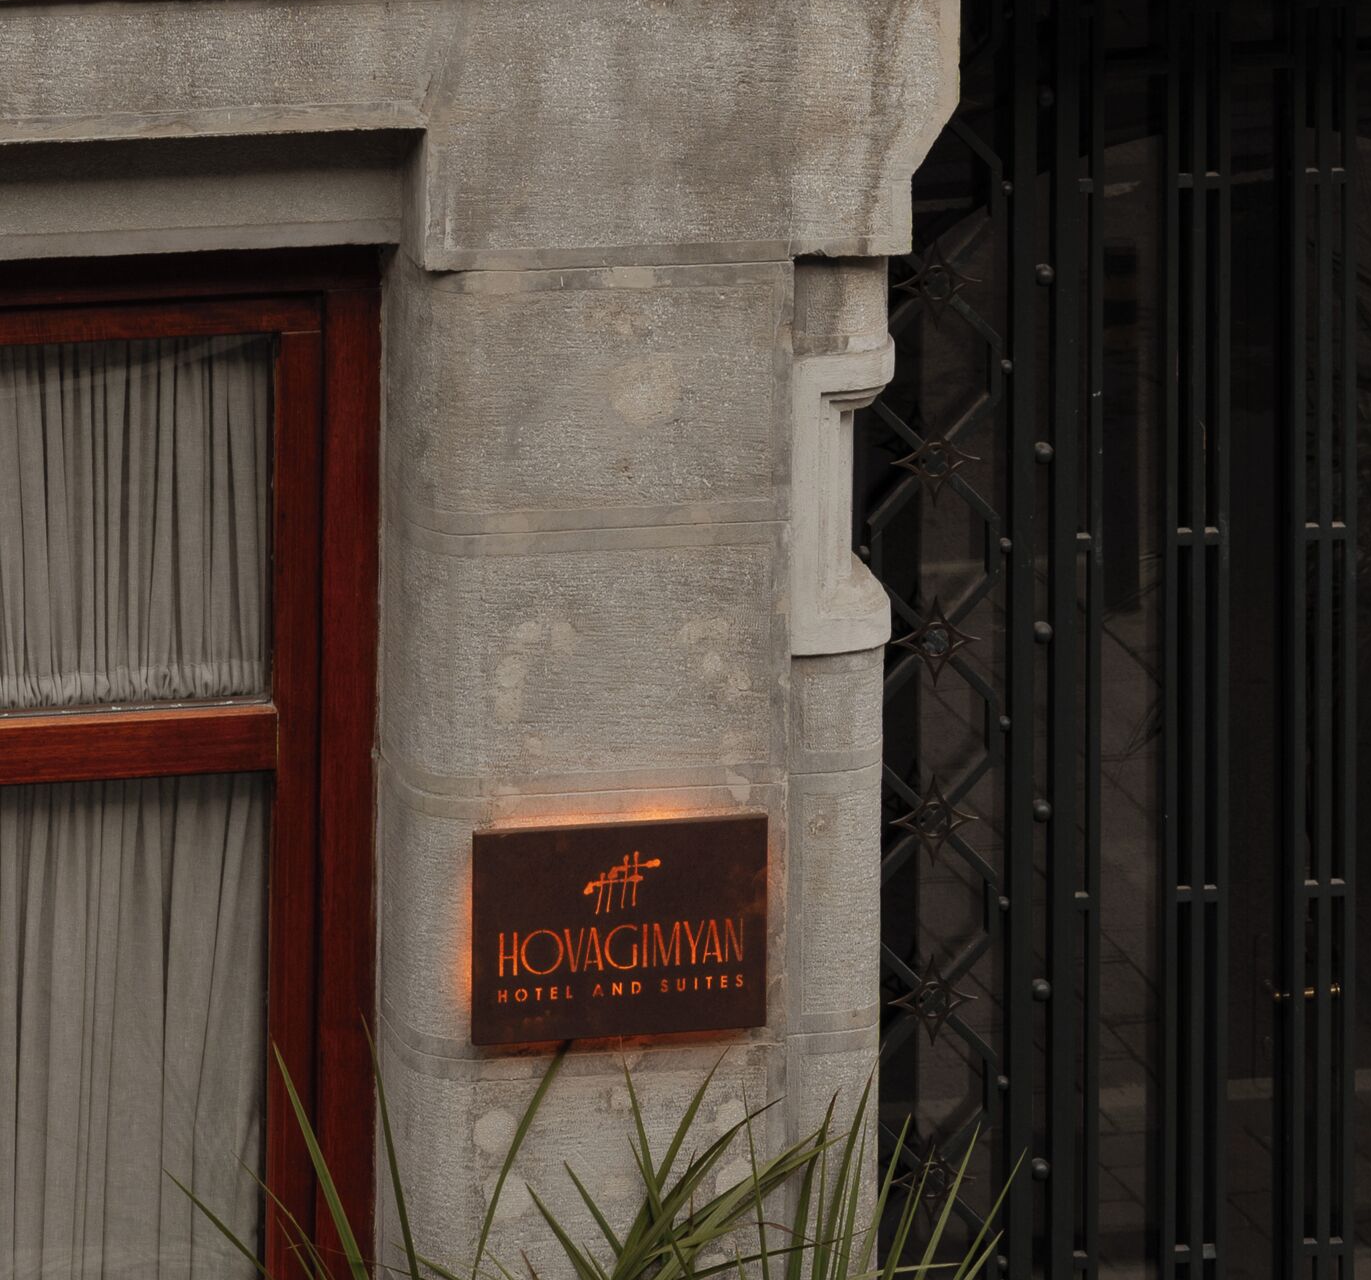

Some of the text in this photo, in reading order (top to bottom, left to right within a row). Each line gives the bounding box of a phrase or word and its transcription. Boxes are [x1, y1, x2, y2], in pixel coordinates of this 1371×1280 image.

[498, 918, 744, 978] HOVAGIMYAN
[497, 974, 744, 1004] HOTEL AND SUITES
